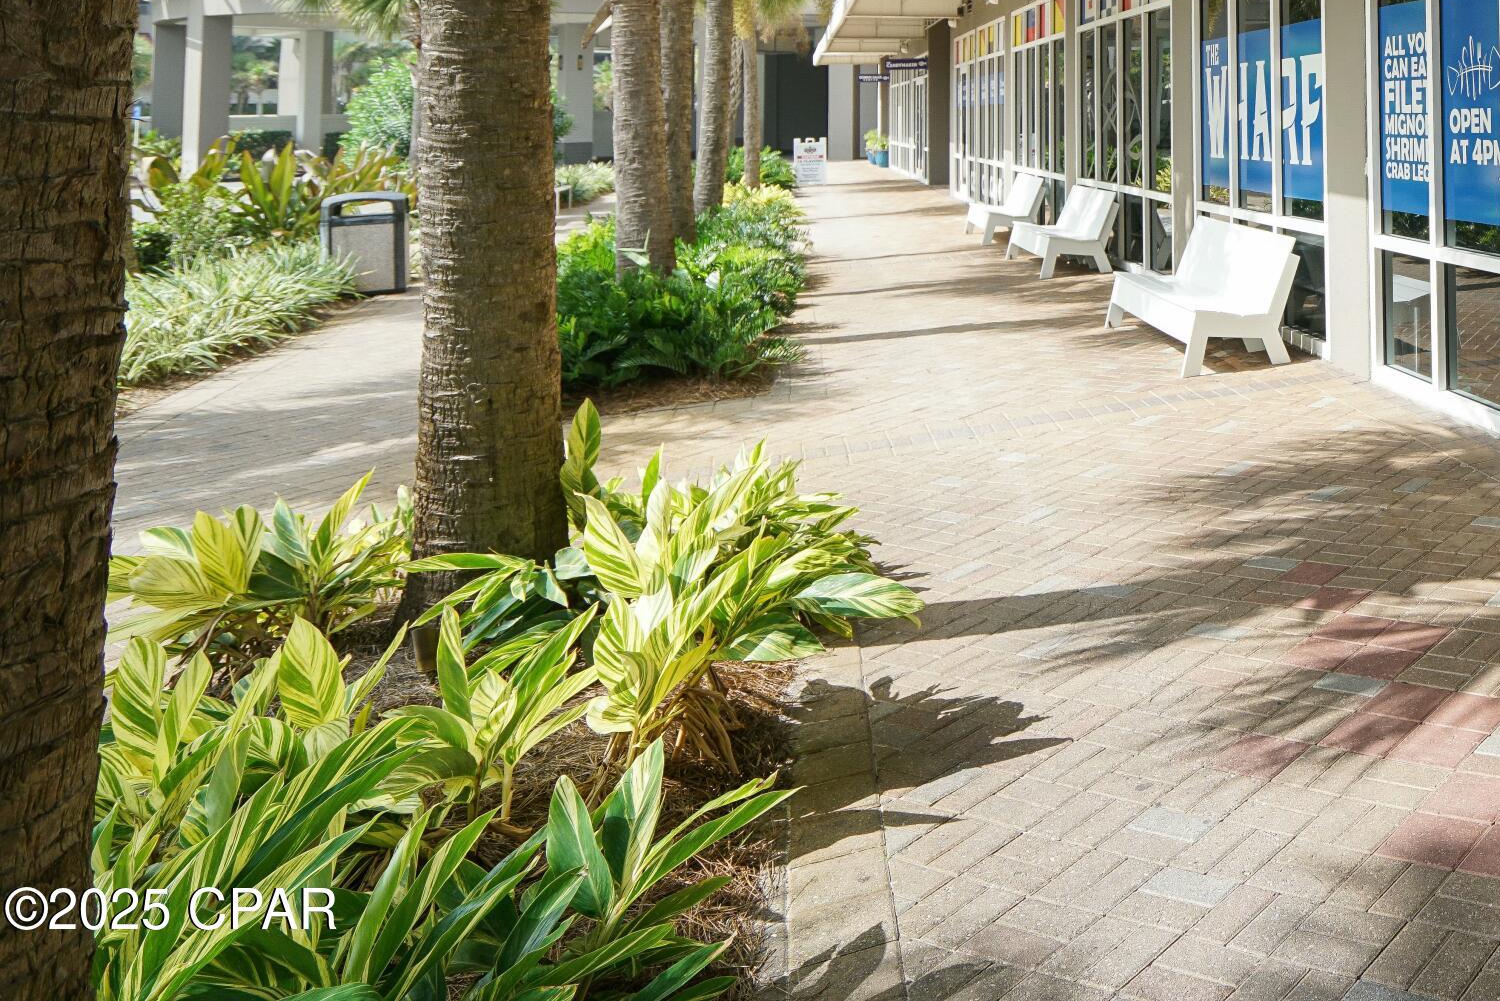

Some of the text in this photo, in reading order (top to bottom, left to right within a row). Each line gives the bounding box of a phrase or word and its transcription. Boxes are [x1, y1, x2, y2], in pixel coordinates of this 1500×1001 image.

[1205, 43, 1220, 67] THE
[1384, 31, 1427, 57] ALL YO
[1384, 55, 1427, 79] CAN EA
[1205, 53, 1323, 166] WHARF
[1449, 107, 1492, 134] OPEN
[1385, 136, 1429, 163] SHRIM
[1450, 139, 1469, 165] AT
[1386, 162, 1410, 181] CRAB
